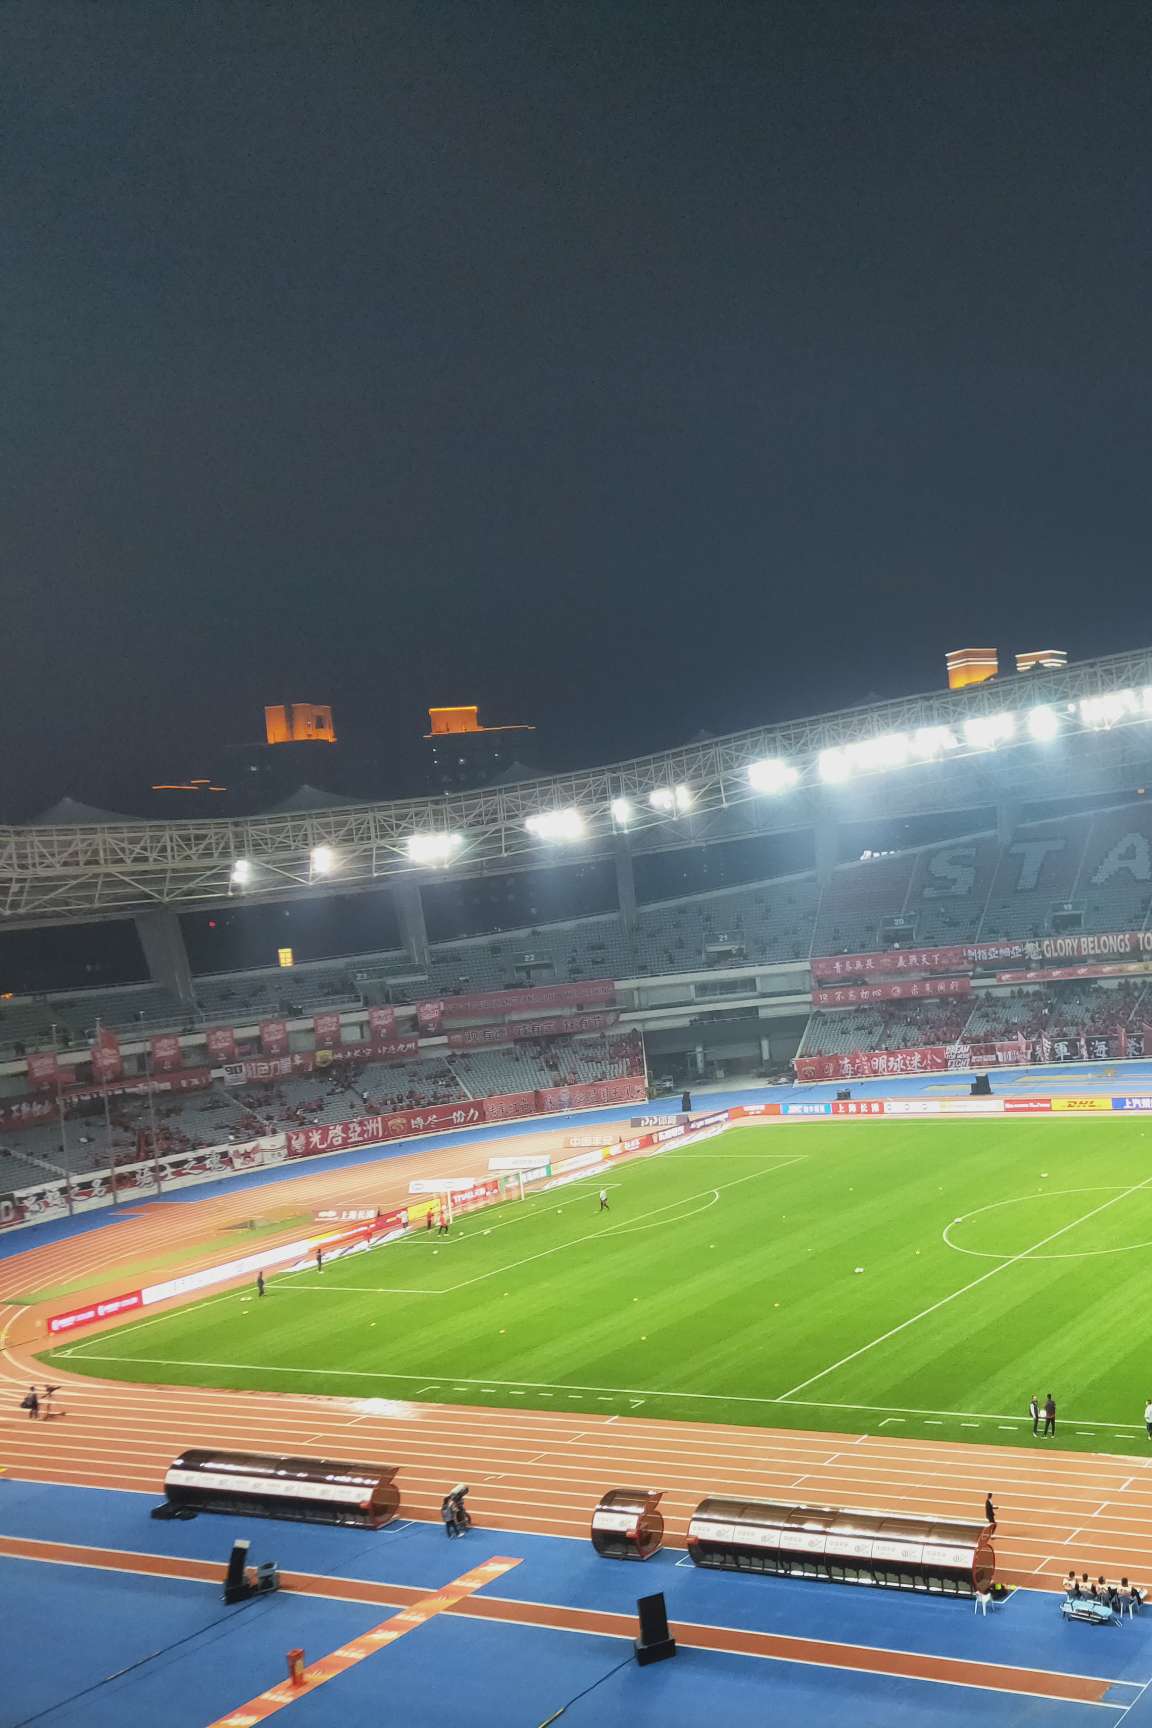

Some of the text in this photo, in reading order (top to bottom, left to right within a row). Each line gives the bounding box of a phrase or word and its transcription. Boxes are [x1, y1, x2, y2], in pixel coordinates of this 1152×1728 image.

[1044, 937, 1079, 958] GLORY
[1081, 933, 1131, 956] BELONGS
[1138, 932, 1152, 950] TO
